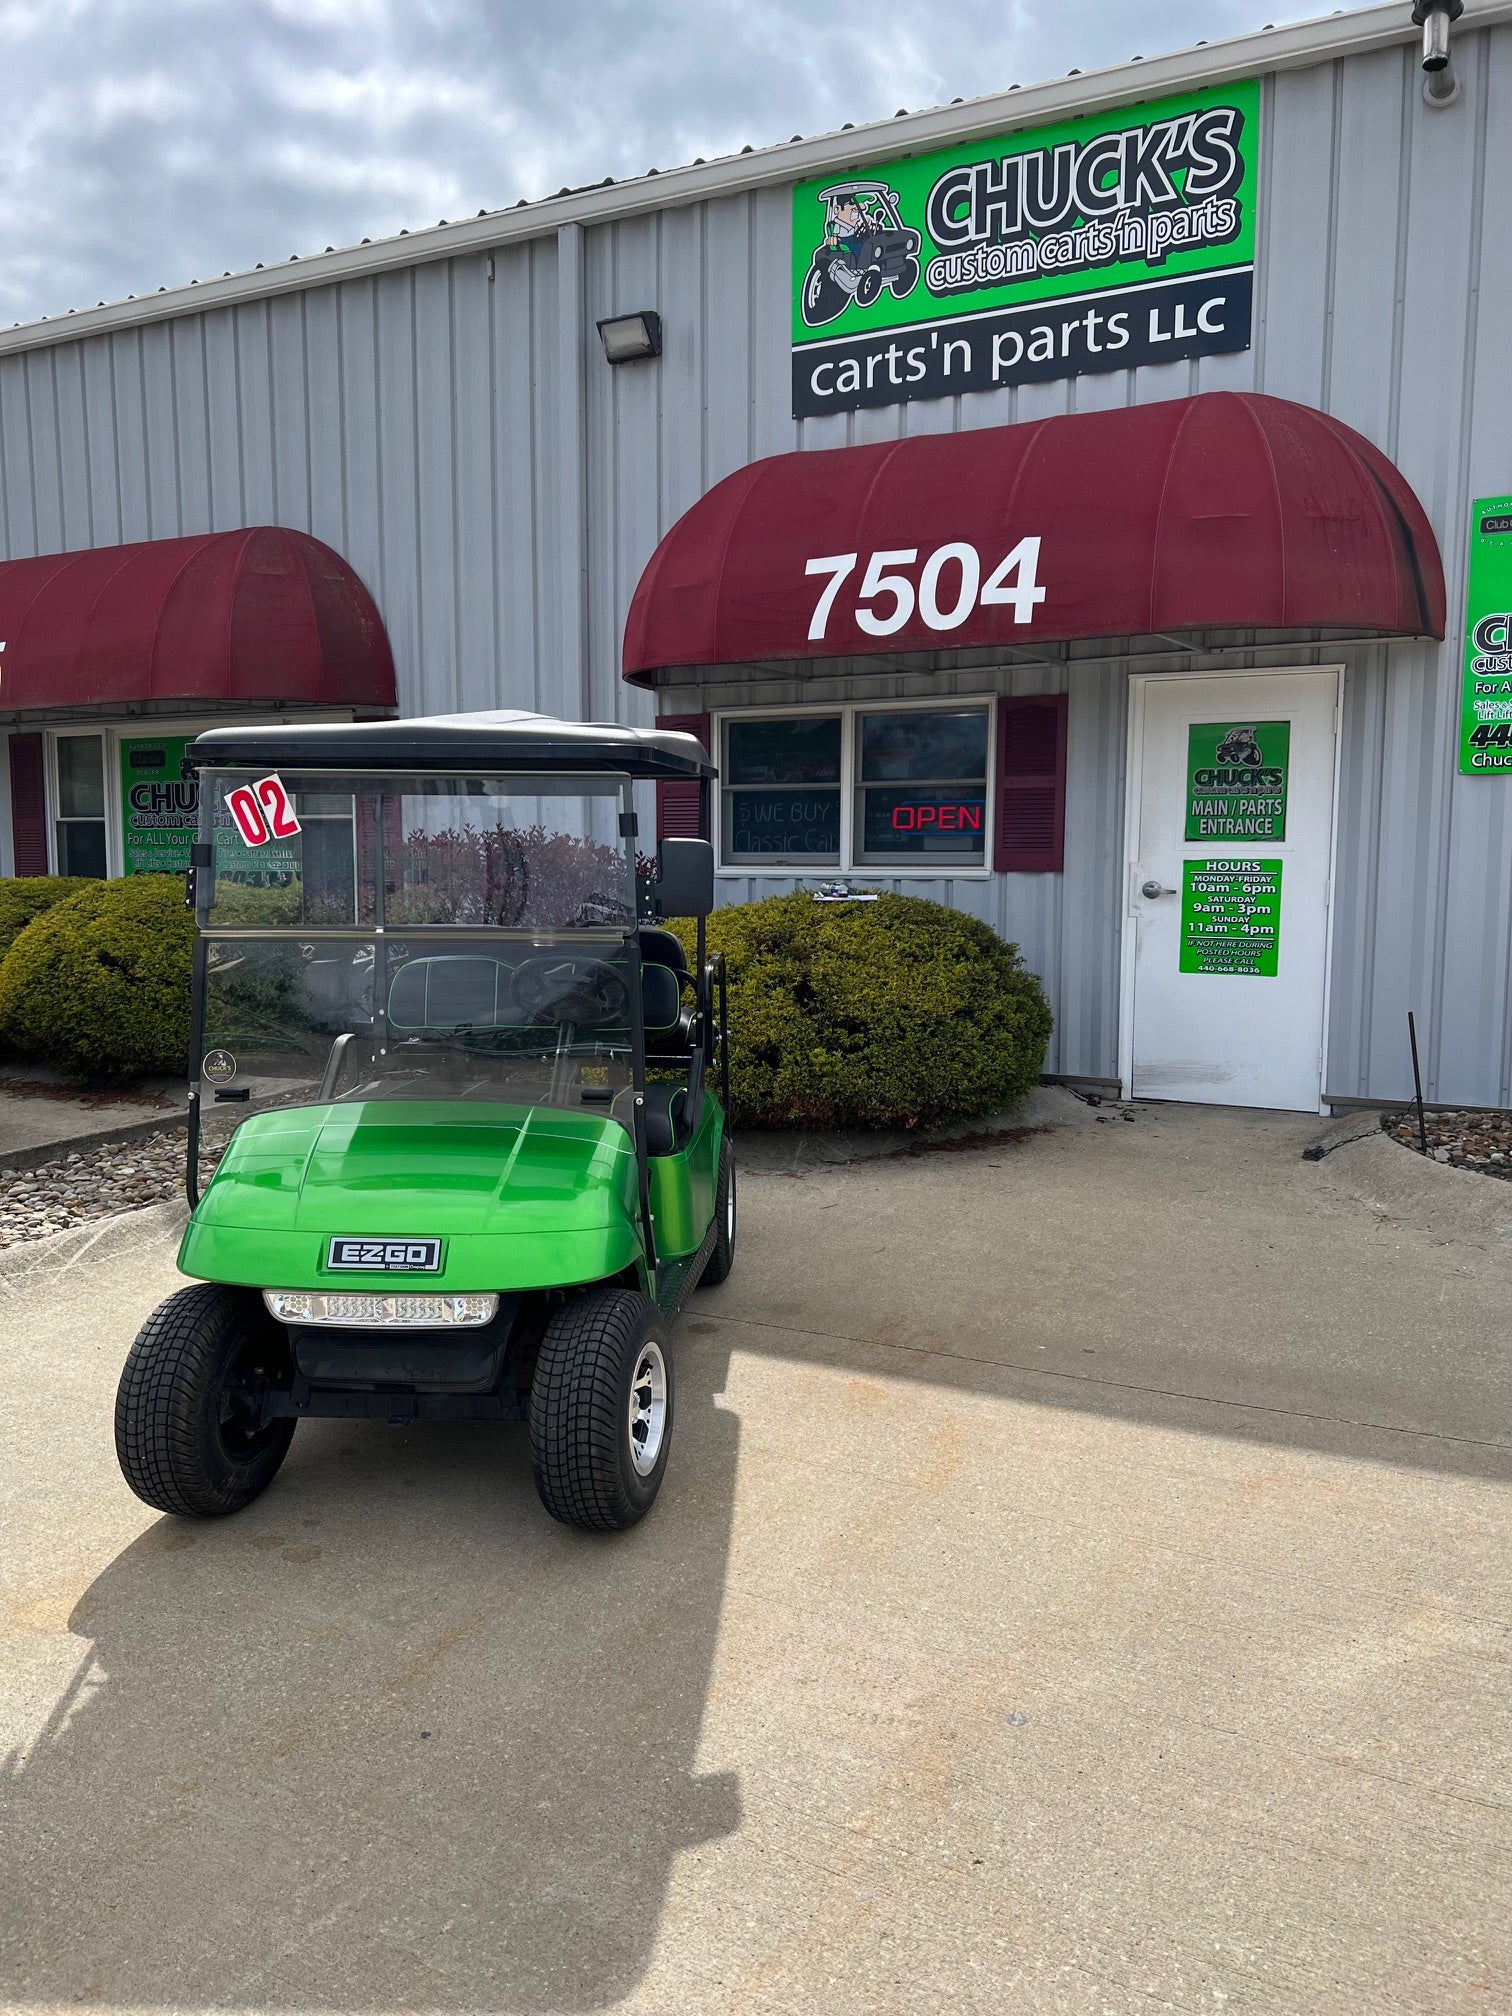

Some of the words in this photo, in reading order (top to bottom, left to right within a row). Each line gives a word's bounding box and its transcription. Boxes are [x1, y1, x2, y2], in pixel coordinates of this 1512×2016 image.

[927, 108, 1238, 247] CHUCK'S
[928, 239, 1038, 290] custom
[1147, 196, 1237, 260] parts
[810, 332, 972, 397] carts'n
[991, 309, 1130, 381] parts
[1149, 297, 1226, 343] LLC
[1486, 520, 1509, 530] Club
[804, 536, 1046, 640] 7504
[1475, 681, 1498, 693] For
[1474, 700, 1500, 710] Sales
[1478, 711, 1494, 720] Lift
[1193, 768, 1283, 788] CHUCK'S
[230, 780, 299, 845] 02
[754, 803, 785, 822] WE
[790, 802, 831, 822] BUY
[1191, 800, 1228, 816] MAIN
[1231, 800, 1237, 816] /
[1239, 799, 1283, 816] PARTS
[130, 813, 181, 828] custom
[892, 806, 981, 830] OPEN
[1199, 818, 1273, 835] ENTRANCE
[128, 832, 144, 845] For
[146, 832, 166, 845] ALL
[166, 832, 190, 845] Your
[216, 831, 239, 846] Cart
[735, 829, 800, 852] Classic
[1206, 861, 1261, 871] HOURS
[1193, 875, 1272, 883] MONDAY-FRIDAY
[1190, 883, 1230, 892] 10am
[1242, 883, 1276, 895] 6pm
[1193, 903, 1225, 912] 9am
[1237, 904, 1271, 915] 3pm
[1211, 915, 1250, 923] SUNDAY
[1188, 923, 1228, 932] 11am
[1240, 924, 1274, 936] 4pm
[1238, 941, 1273, 949] DURING
[1230, 949, 1261, 957] HOURS
[341, 1244, 427, 1263] EZGO
